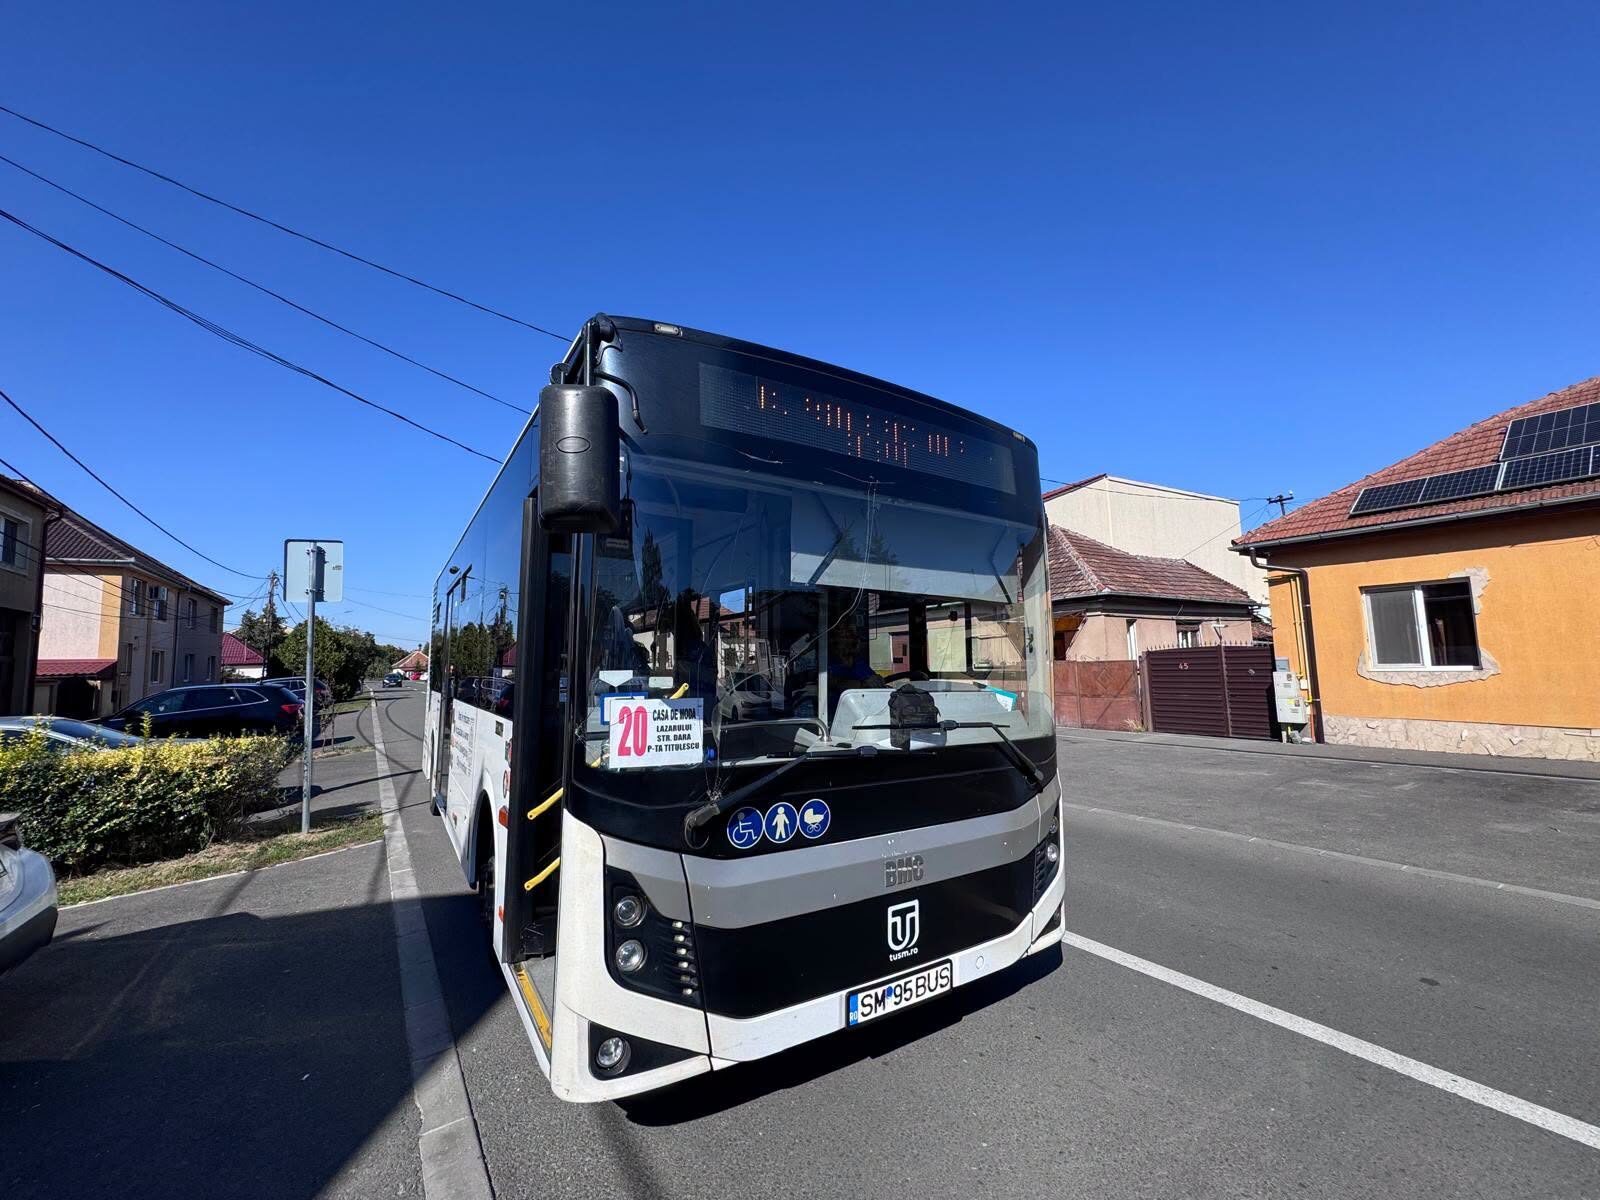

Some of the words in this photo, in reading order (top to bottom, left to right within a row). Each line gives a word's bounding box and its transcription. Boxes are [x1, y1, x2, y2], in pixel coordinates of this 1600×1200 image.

[1178, 662, 1189, 670] 45
[652, 709, 669, 721] CASA
[670, 708, 679, 720] DE
[679, 707, 697, 720] MODA
[617, 705, 648, 757] 20
[656, 724, 692, 732] LAZARULUI
[656, 734, 672, 742] STR.
[673, 733, 691, 741] DARA
[647, 743, 663, 753] P-TA
[664, 741, 700, 752] TITULESCU
[885, 855, 924, 888] BMC
[889, 947, 919, 962] tusm.ro
[860, 988, 887, 1018] SM
[849, 1012, 858, 1022] RO
